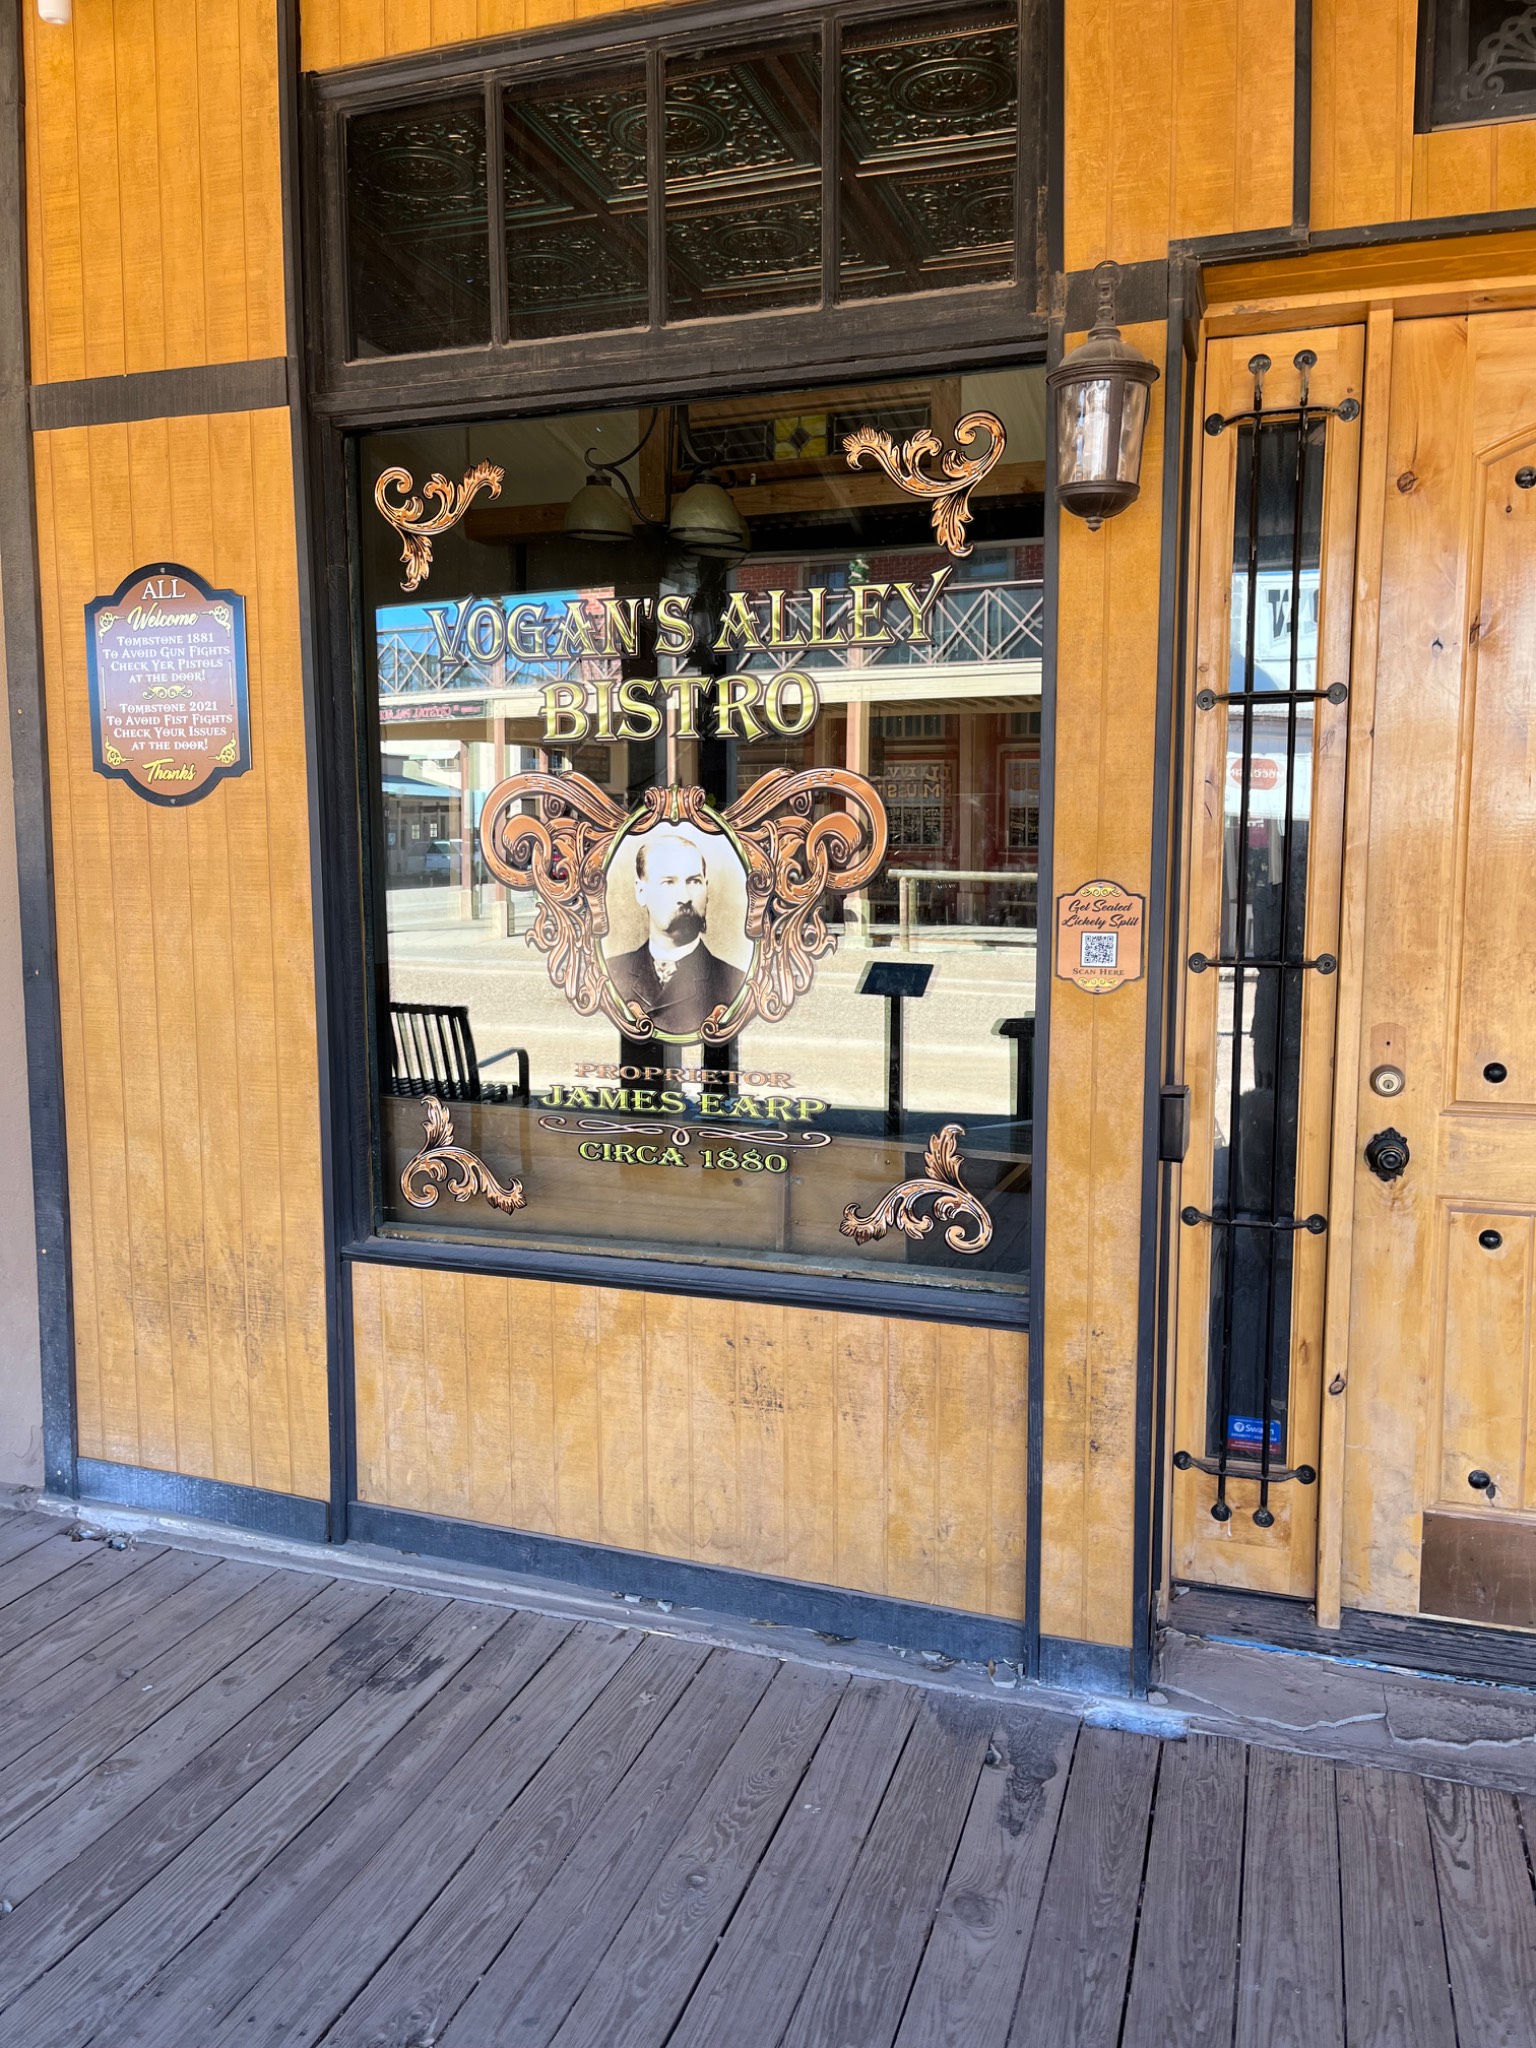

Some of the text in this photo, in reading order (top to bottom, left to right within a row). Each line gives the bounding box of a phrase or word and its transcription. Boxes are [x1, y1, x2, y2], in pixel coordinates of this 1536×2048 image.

[141, 578, 186, 600] ALL
[127, 602, 199, 632] Welcome
[423, 564, 953, 665] VOGAN'S ALLEY
[116, 632, 214, 648] TOMBSTONE 1881
[103, 645, 231, 659] TO AVOID GUN FIGHTS
[110, 658, 223, 672] CHECK YER PISTOLS
[129, 669, 206, 684] AT THE DOOR!
[119, 701, 217, 715] TOMBSTONE 2021
[540, 669, 821, 744] BISTRO
[106, 712, 233, 726] TO AVOID FIST FIGHTS
[113, 724, 227, 739] CHECK YOUR ISSUES
[131, 737, 209, 751] AT THE DOOR!
[142, 758, 197, 784] Thanks
[1109, 914, 1140, 929] Split
[1073, 967, 1125, 976] SCAN HERE
[575, 1062, 795, 1089] PROPRIETOR
[541, 1084, 831, 1122] JAMES EARP
[578, 1141, 789, 1173] CIRCA 1880
